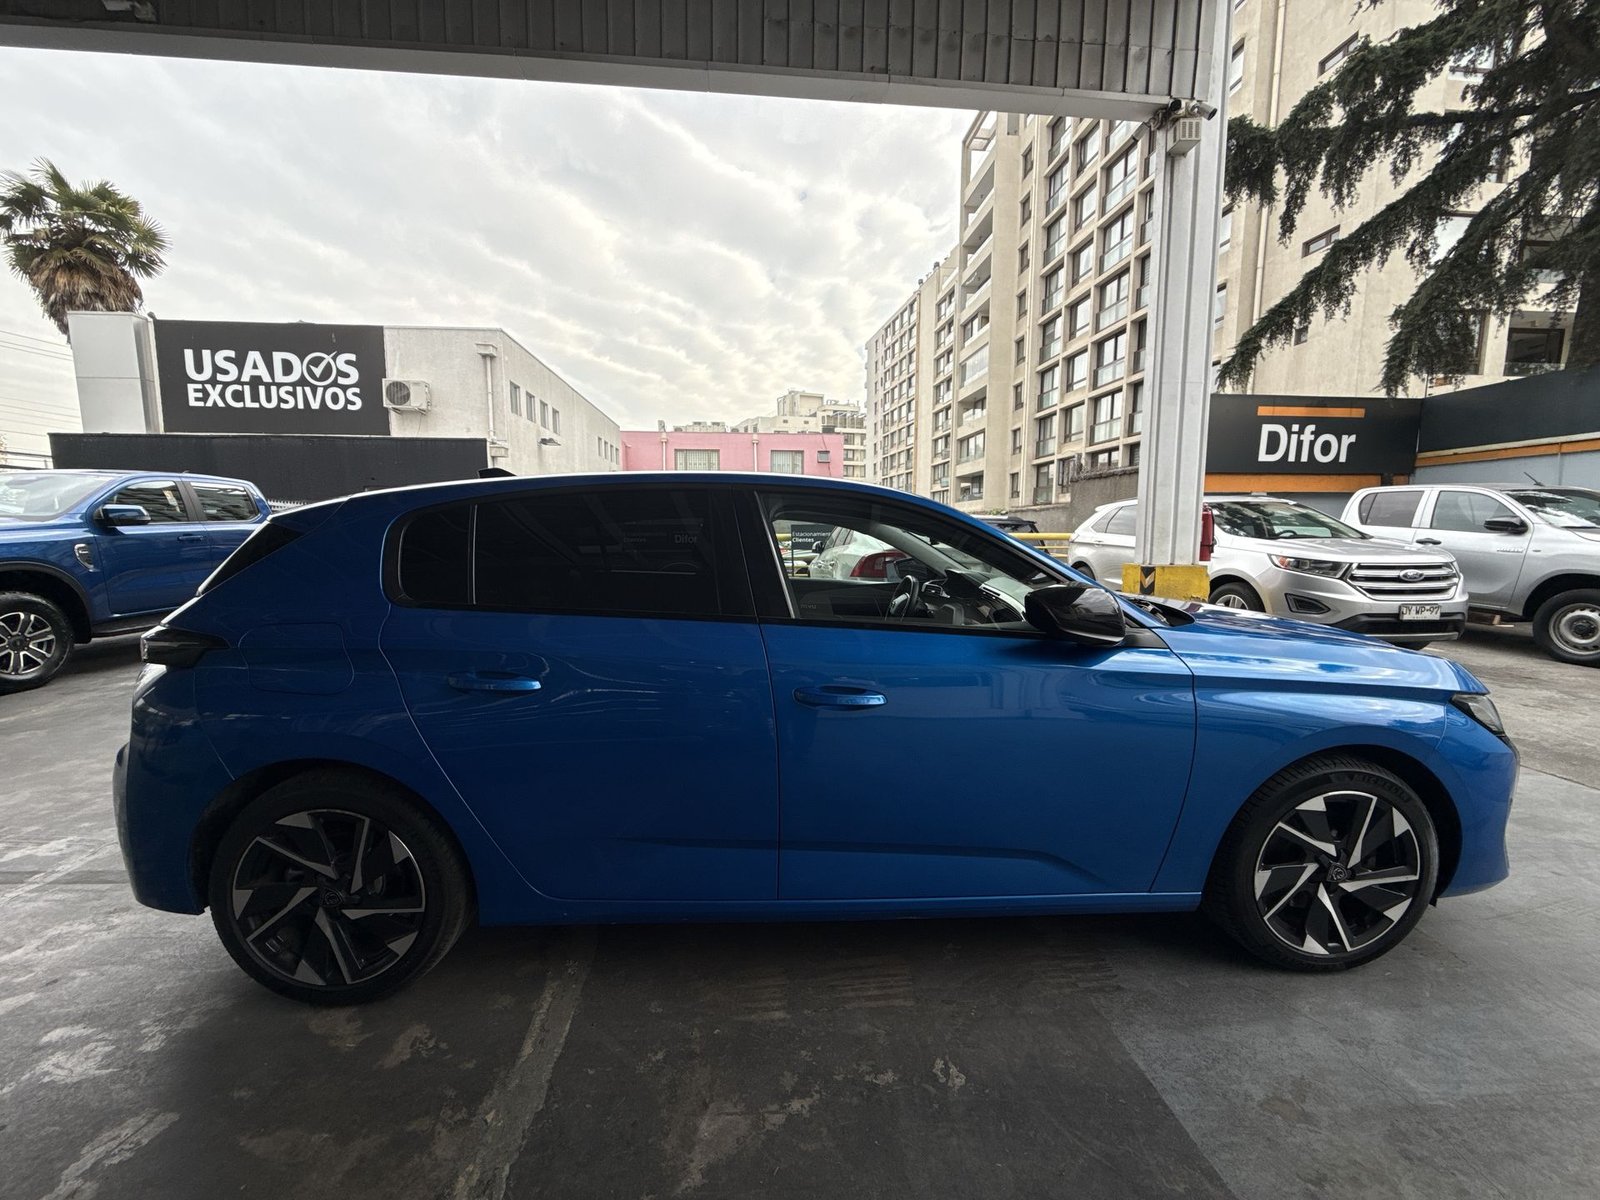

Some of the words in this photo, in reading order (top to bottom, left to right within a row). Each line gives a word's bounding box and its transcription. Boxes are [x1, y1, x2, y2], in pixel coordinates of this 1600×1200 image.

[184, 349, 359, 386] USADOS
[187, 383, 363, 411] EXCLUSIVOS
[1257, 423, 1357, 464] Difor
